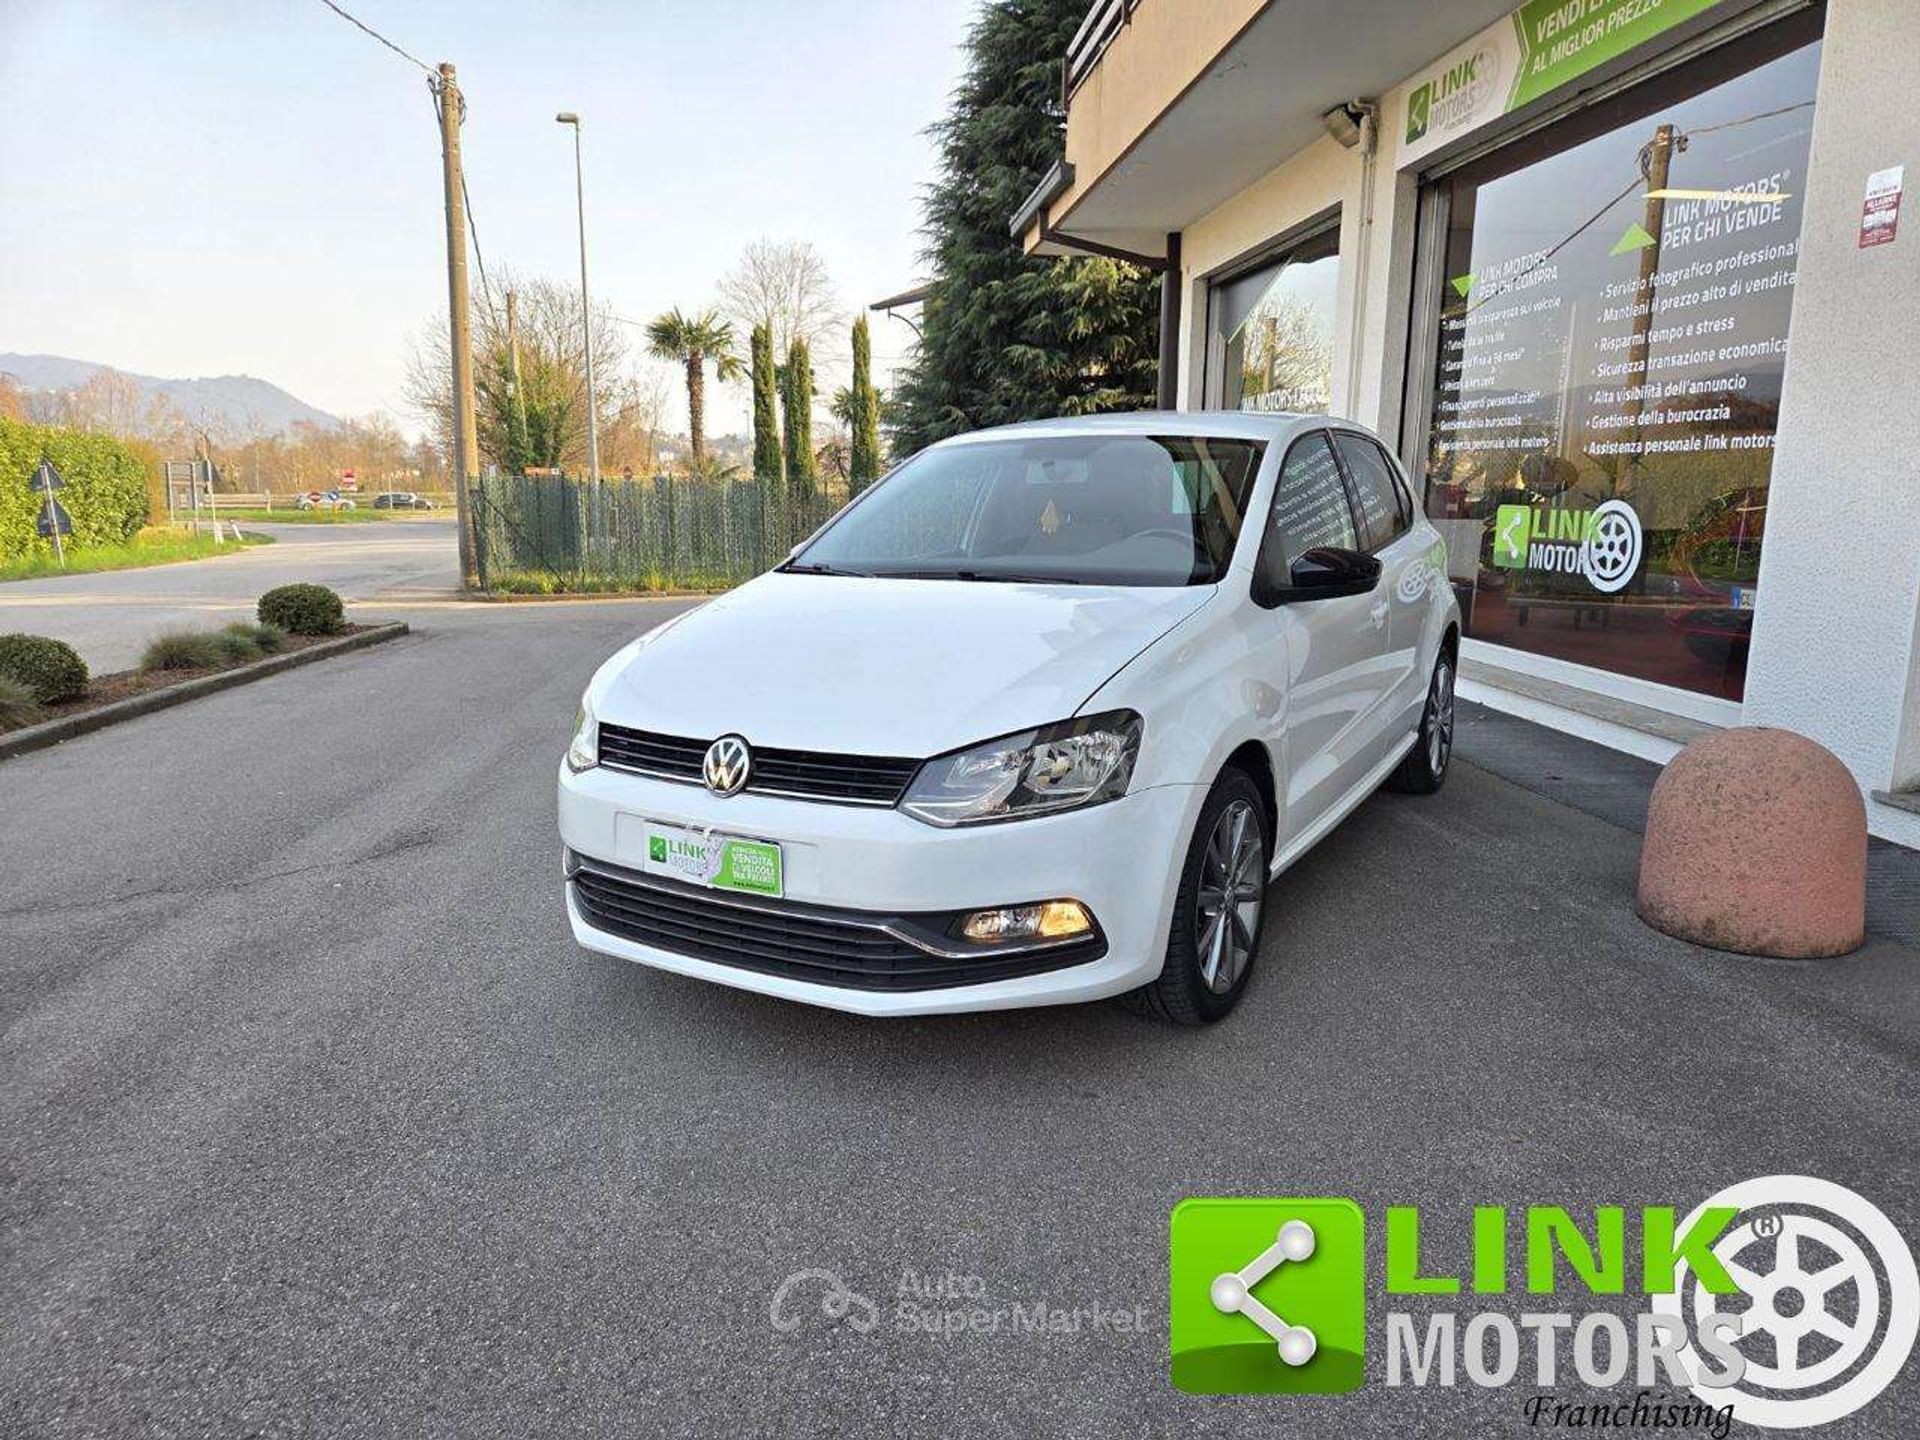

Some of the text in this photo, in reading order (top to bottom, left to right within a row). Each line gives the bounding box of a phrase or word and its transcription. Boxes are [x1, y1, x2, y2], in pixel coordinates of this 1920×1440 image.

[1536, 0, 1586, 43] VENDI
[1532, 53, 1547, 75] AL
[1550, 19, 1605, 65] MIGLIOR
[1431, 55, 1477, 105] LINK
[1662, 201, 1782, 250] PER CHI VENDE
[1665, 198, 1701, 229] LINK
[1603, 298, 1650, 323] Mantieni
[1660, 291, 1700, 313] prezzo
[1702, 283, 1726, 302] alto
[1729, 279, 1742, 297] di
[1746, 270, 1798, 293] vendita
[1606, 277, 1647, 298] Servizio
[1649, 261, 1713, 287] fotografico
[1600, 315, 1735, 352] Risparmi tempo e stress
[1597, 360, 1645, 378] Sicurezza
[1648, 348, 1716, 370] transazione
[1617, 380, 1662, 401] visibilità
[1665, 374, 1748, 398] dell'annuncio
[1591, 404, 1731, 430] Gestione della burocrazia
[1589, 434, 1776, 456] Assistenza personale link motors
[1531, 508, 1605, 545] LINK
[705, 738, 750, 791] VW
[669, 839, 706, 861] LINK
